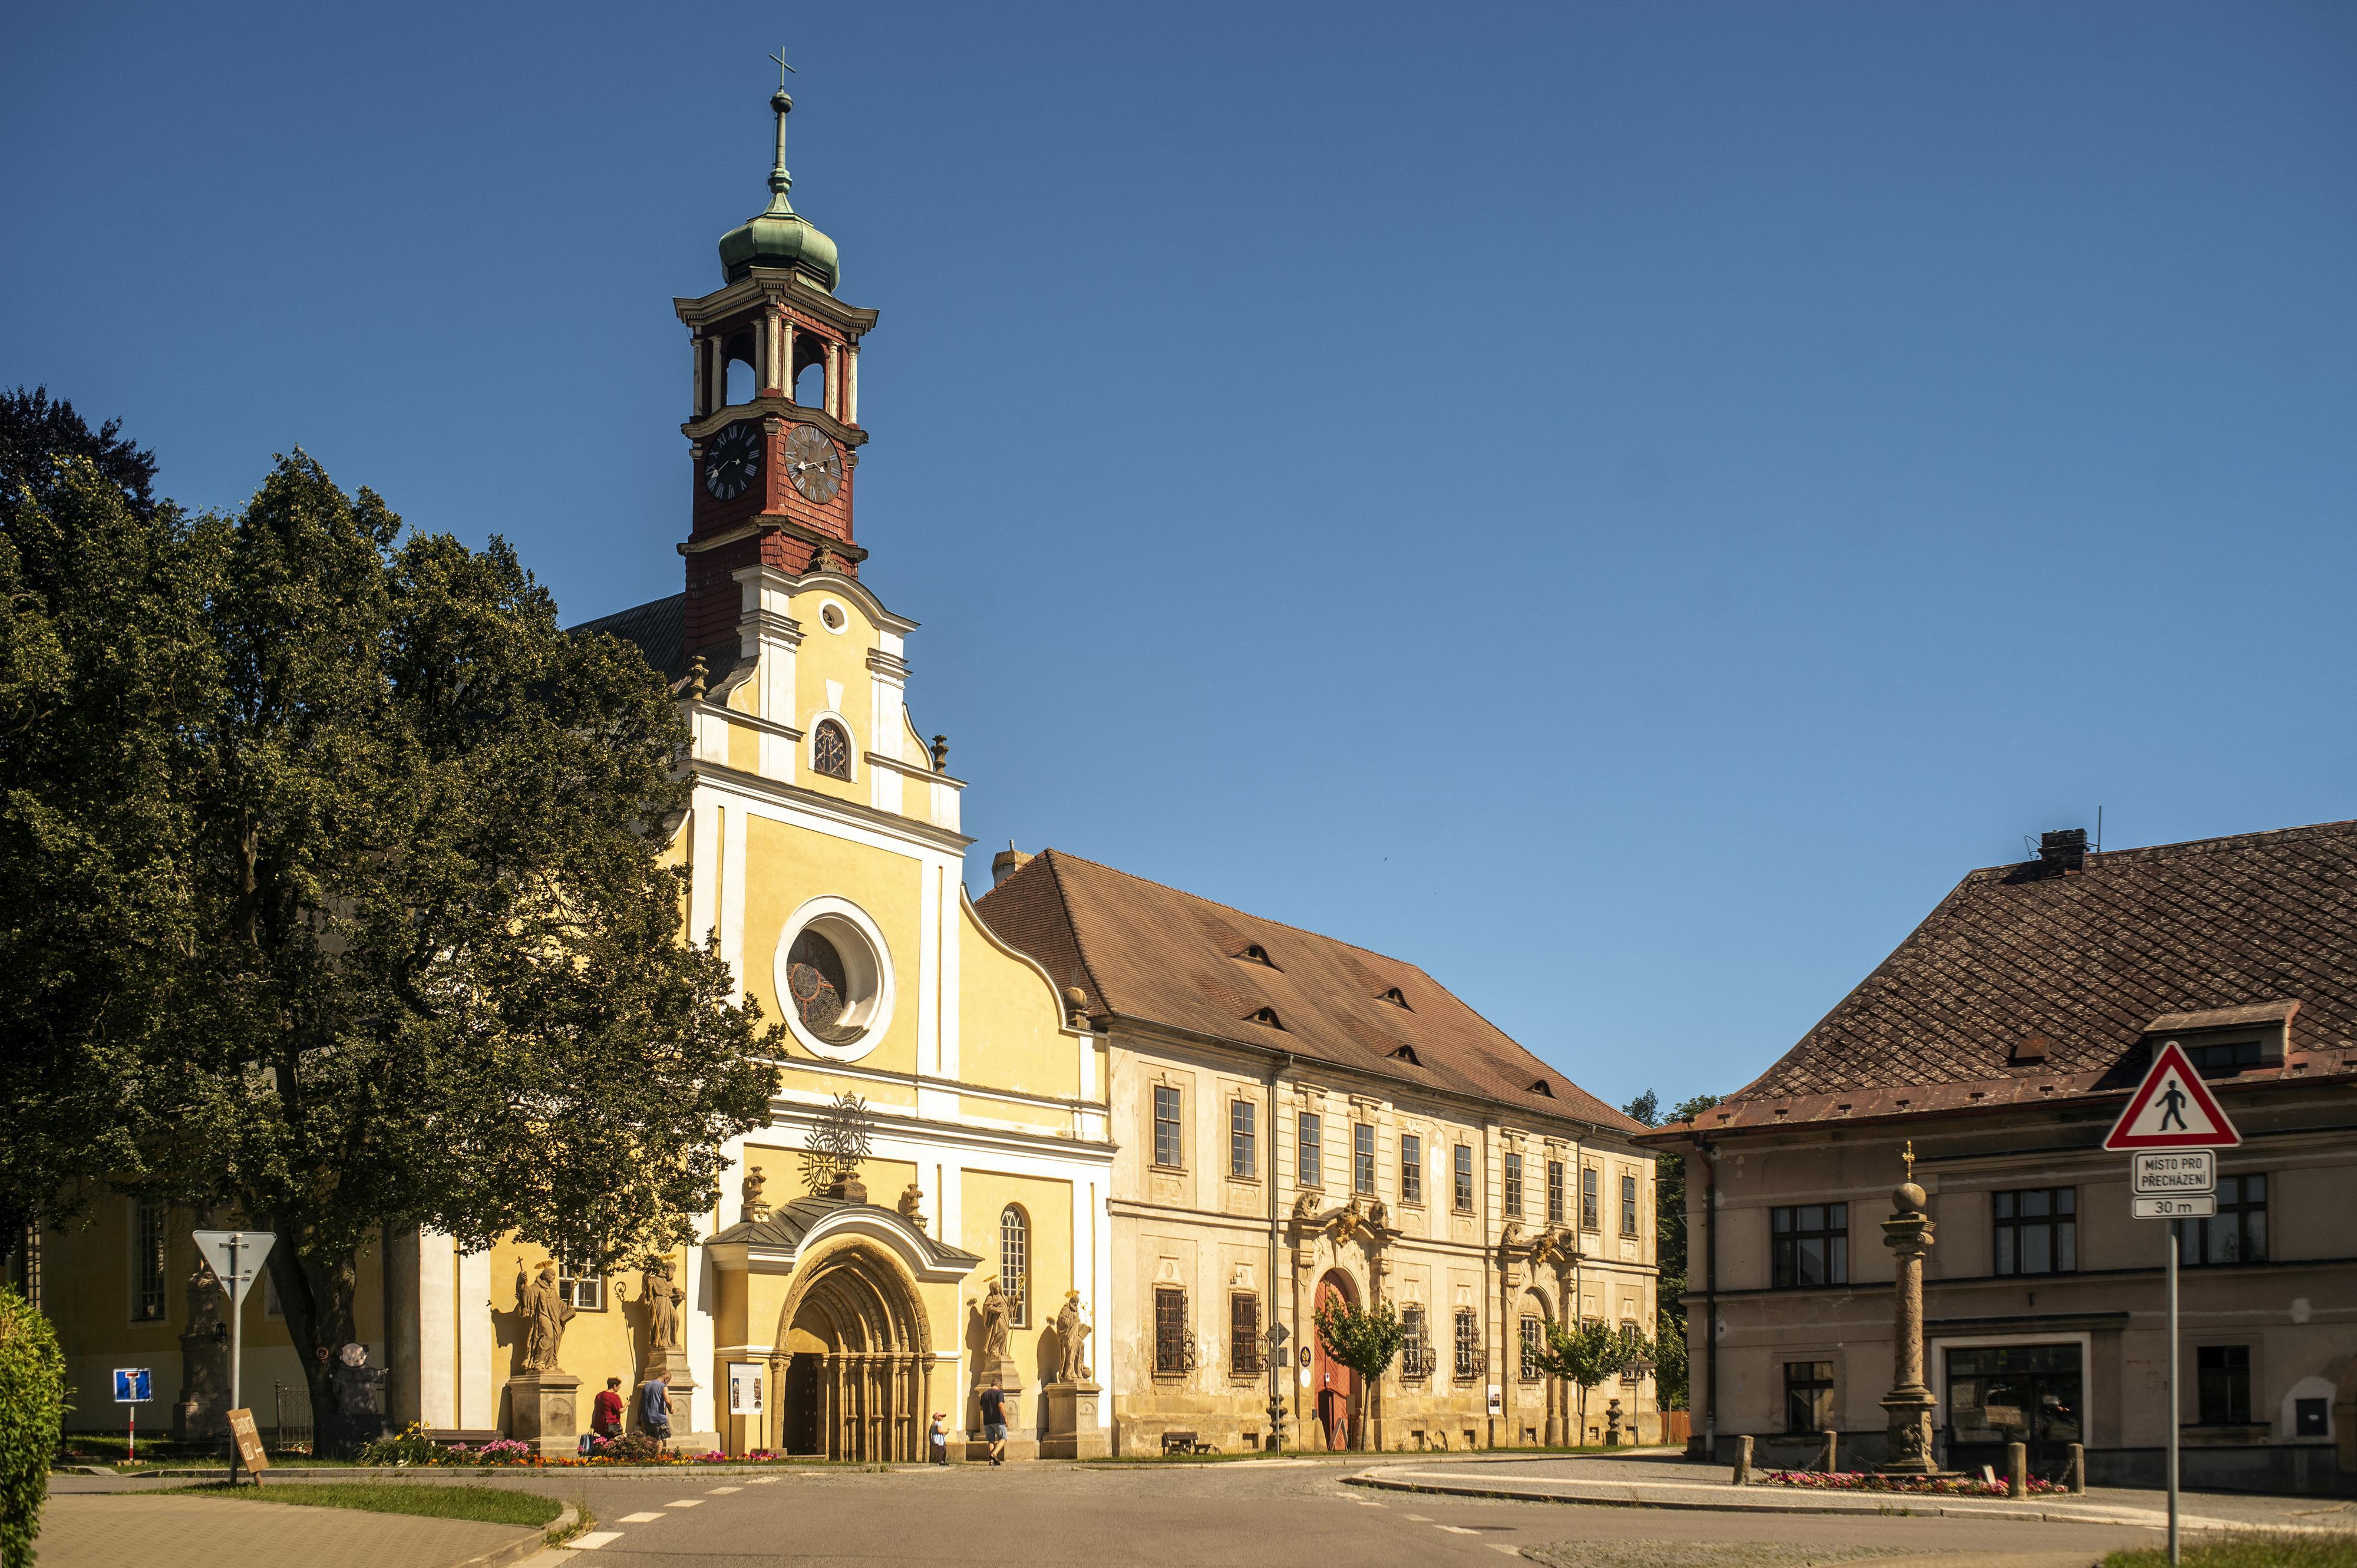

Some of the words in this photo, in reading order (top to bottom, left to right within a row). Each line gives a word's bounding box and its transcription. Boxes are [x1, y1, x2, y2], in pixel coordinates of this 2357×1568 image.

[728, 424, 737, 440] XII
[717, 433, 727, 448] XI
[745, 433, 757, 447] II
[708, 449, 719, 458] X
[748, 450, 760, 460] III
[2145, 1157, 2178, 1171] MÍSTO
[2181, 1158, 2203, 1169] PRO
[2142, 1171, 2207, 1187] PŘECHÁZENÍ
[2155, 1201, 2173, 1214] 30
[2178, 1203, 2193, 1213] m
